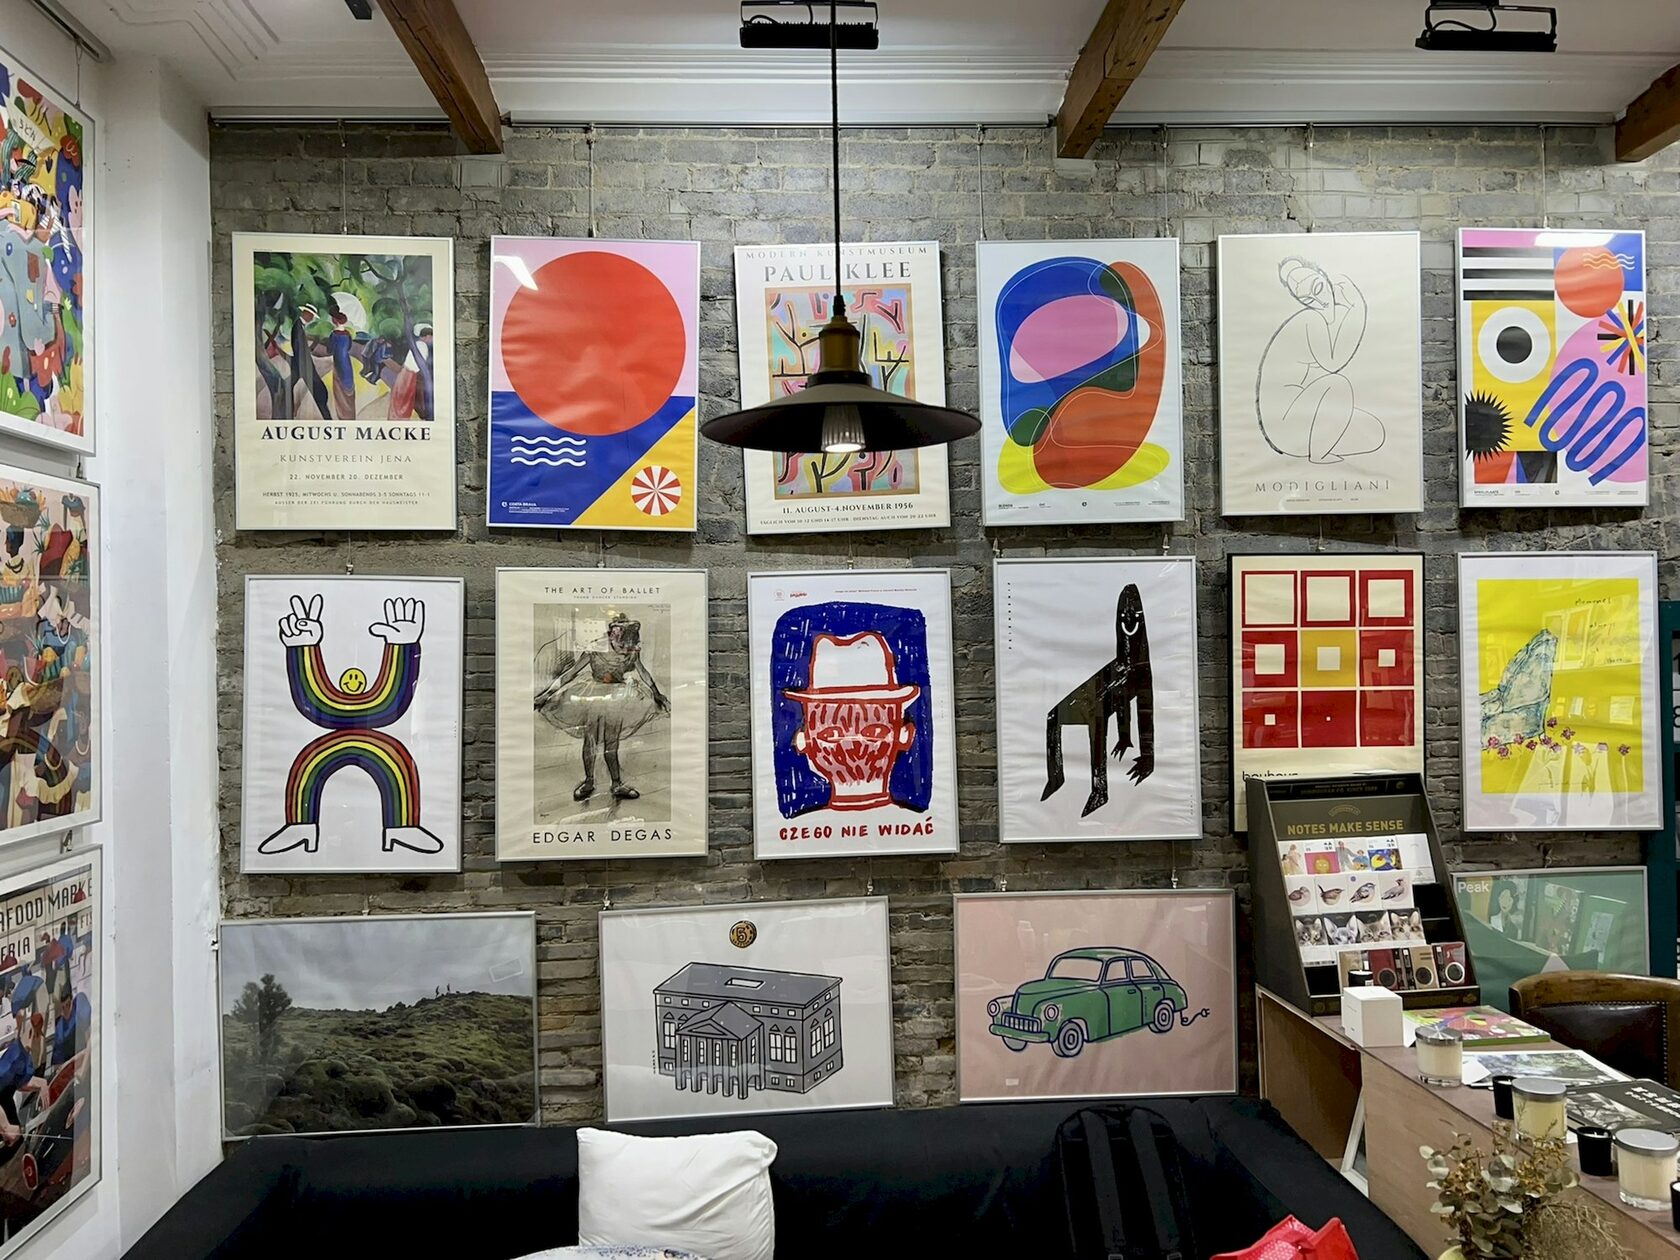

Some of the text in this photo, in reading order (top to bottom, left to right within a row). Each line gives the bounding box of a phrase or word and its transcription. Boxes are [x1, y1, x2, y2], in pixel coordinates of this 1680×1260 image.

[745, 246, 928, 260] MODERN KUNSTMUSEUM
[764, 261, 912, 282] PAUL KLEE
[261, 426, 431, 441] AUGUST MACKE
[279, 454, 412, 464] KUNSTVEREIN JENA
[1255, 480, 1391, 493] MODIGLIANI
[894, 502, 914, 510] 1956
[779, 816, 934, 841] CZEGO NIE WIDAĆ
[1287, 819, 1404, 835] NOTES MAKE SENSE
[532, 828, 672, 843] EDGAR DEGAS
[1457, 880, 1490, 893] Peak
[736, 927, 748, 943] 5
